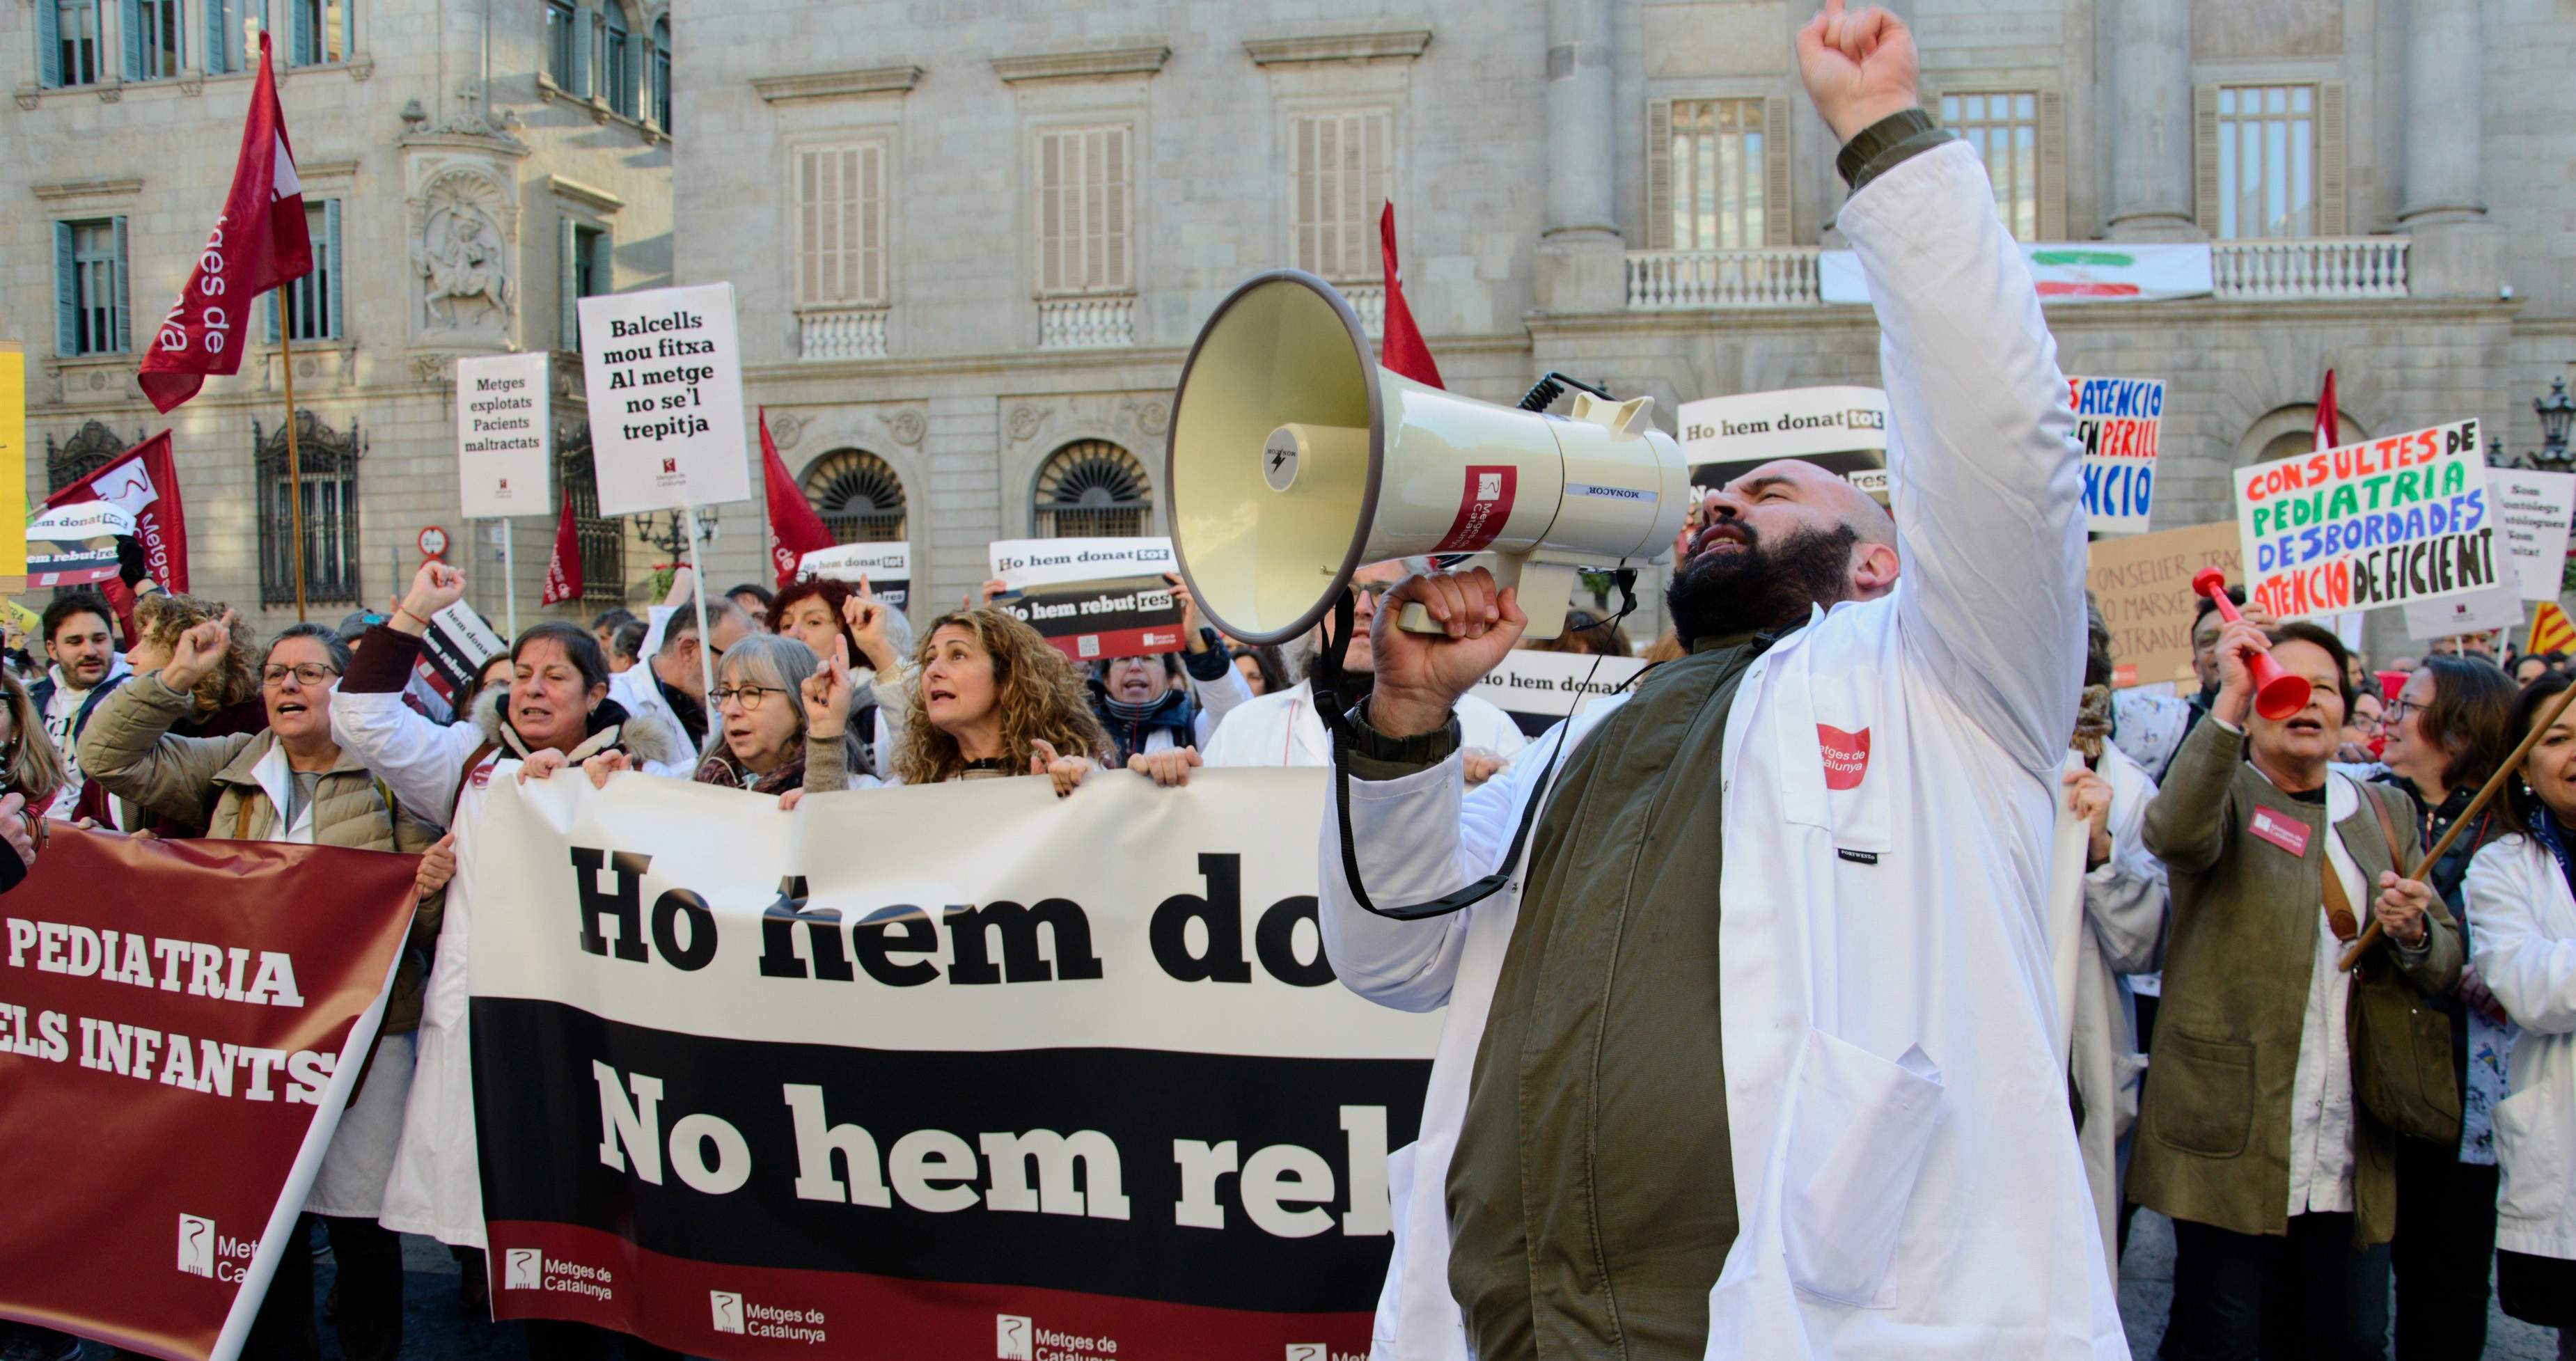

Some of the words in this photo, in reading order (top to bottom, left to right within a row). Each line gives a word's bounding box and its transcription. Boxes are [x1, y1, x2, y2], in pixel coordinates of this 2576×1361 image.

[200, 215, 228, 295] ges
[203, 306, 230, 354] de
[611, 311, 702, 338] Balcells
[604, 347, 652, 364] mou
[658, 338, 716, 358] fitxa
[476, 378, 526, 393] Metges
[609, 369, 636, 389] Al
[642, 365, 714, 385] metge
[470, 398, 533, 414] explotats
[626, 399, 654, 413] no
[661, 388, 700, 409] se'l
[473, 418, 530, 432] Pacients
[623, 415, 710, 441] trepitja
[1687, 423, 1715, 441] Ho
[1721, 420, 1770, 436] hem
[1777, 411, 1844, 430] donat
[1849, 409, 1883, 427] tot
[464, 437, 540, 452] maltractats
[2078, 420, 2099, 455] EN
[2100, 420, 2158, 457] PERILL
[2247, 429, 2438, 501] CONSULTES
[2447, 421, 2476, 455] DE
[2081, 460, 2152, 517] NCIÓ
[2253, 460, 2465, 537] PEDIATRIA
[59, 514, 102, 527] donat
[2258, 488, 2485, 572] DESBORDADES
[53, 550, 96, 563] rebut
[776, 548, 796, 571] de
[819, 560, 842, 569] hem
[845, 557, 881, 567] donat
[883, 557, 904, 567] tot
[998, 558, 1023, 572] Ho
[1030, 555, 1071, 567] hem
[1077, 551, 1135, 563] donat
[1138, 549, 1169, 560] tot
[2254, 553, 2353, 618] ATENCIÓ
[2353, 528, 2495, 605] DEFICIENT
[885, 592, 904, 601] res
[1031, 602, 1077, 620] hem
[1080, 595, 1136, 615] rebut
[1140, 593, 1171, 608] res
[441, 651, 469, 686] rebut
[1510, 672, 1555, 690] hem
[1851, 750, 1866, 761] de
[570, 845, 718, 972] Ho
[759, 874, 1103, 987] hem
[6, 917, 304, 1008] PEDIATRIA
[79, 1016, 337, 1106] INFANTS
[592, 1058, 752, 1195] No
[783, 1083, 1130, 1213] hem
[544, 1259, 595, 1280] Metges
[597, 1267, 612, 1283] de
[544, 1275, 612, 1301] Catalunya
[746, 1303, 803, 1324] Metges
[805, 1309, 826, 1324] de
[747, 1321, 826, 1345] Catalunya
[1035, 1328, 1094, 1353] Metges
[1096, 1337, 1117, 1353] de
